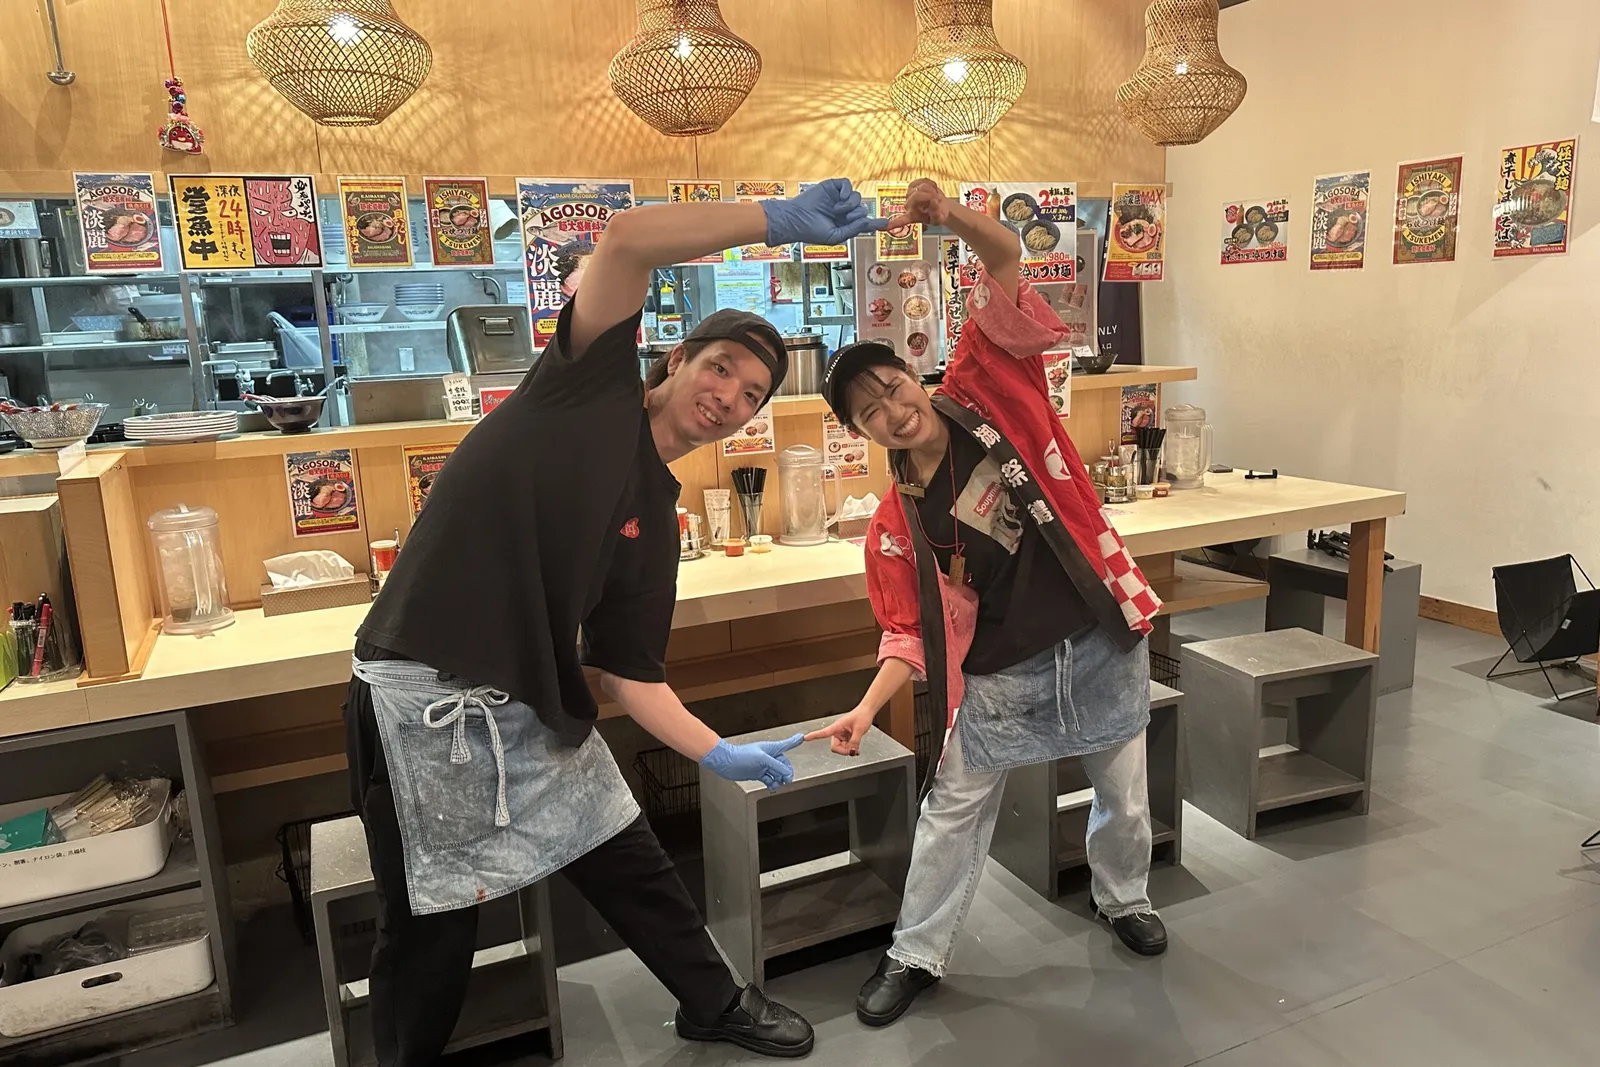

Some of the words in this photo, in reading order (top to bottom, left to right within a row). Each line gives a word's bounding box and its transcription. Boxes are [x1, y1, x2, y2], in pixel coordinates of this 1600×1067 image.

[1411, 172, 1446, 187] ISHIYAKI
[89, 186, 141, 200] AGOSOBA
[215, 184, 242, 198] 深夜
[439, 189, 473, 201] ISHIYAKI
[1140, 188, 1164, 205] MAX
[1322, 186, 1361, 202] AGOSOBA
[1499, 152, 1516, 240] 煮干しまそば
[83, 210, 109, 249] 淡麗
[1313, 211, 1329, 250] 淡麗
[1406, 229, 1444, 244] TSUKEMEN
[444, 235, 482, 249] TSUKEMEN
[528, 244, 564, 311] 淡麗
[1098, 325, 1118, 336] NLY
[297, 460, 341, 474] AGOSOBA
[291, 482, 314, 517] 淡麗
